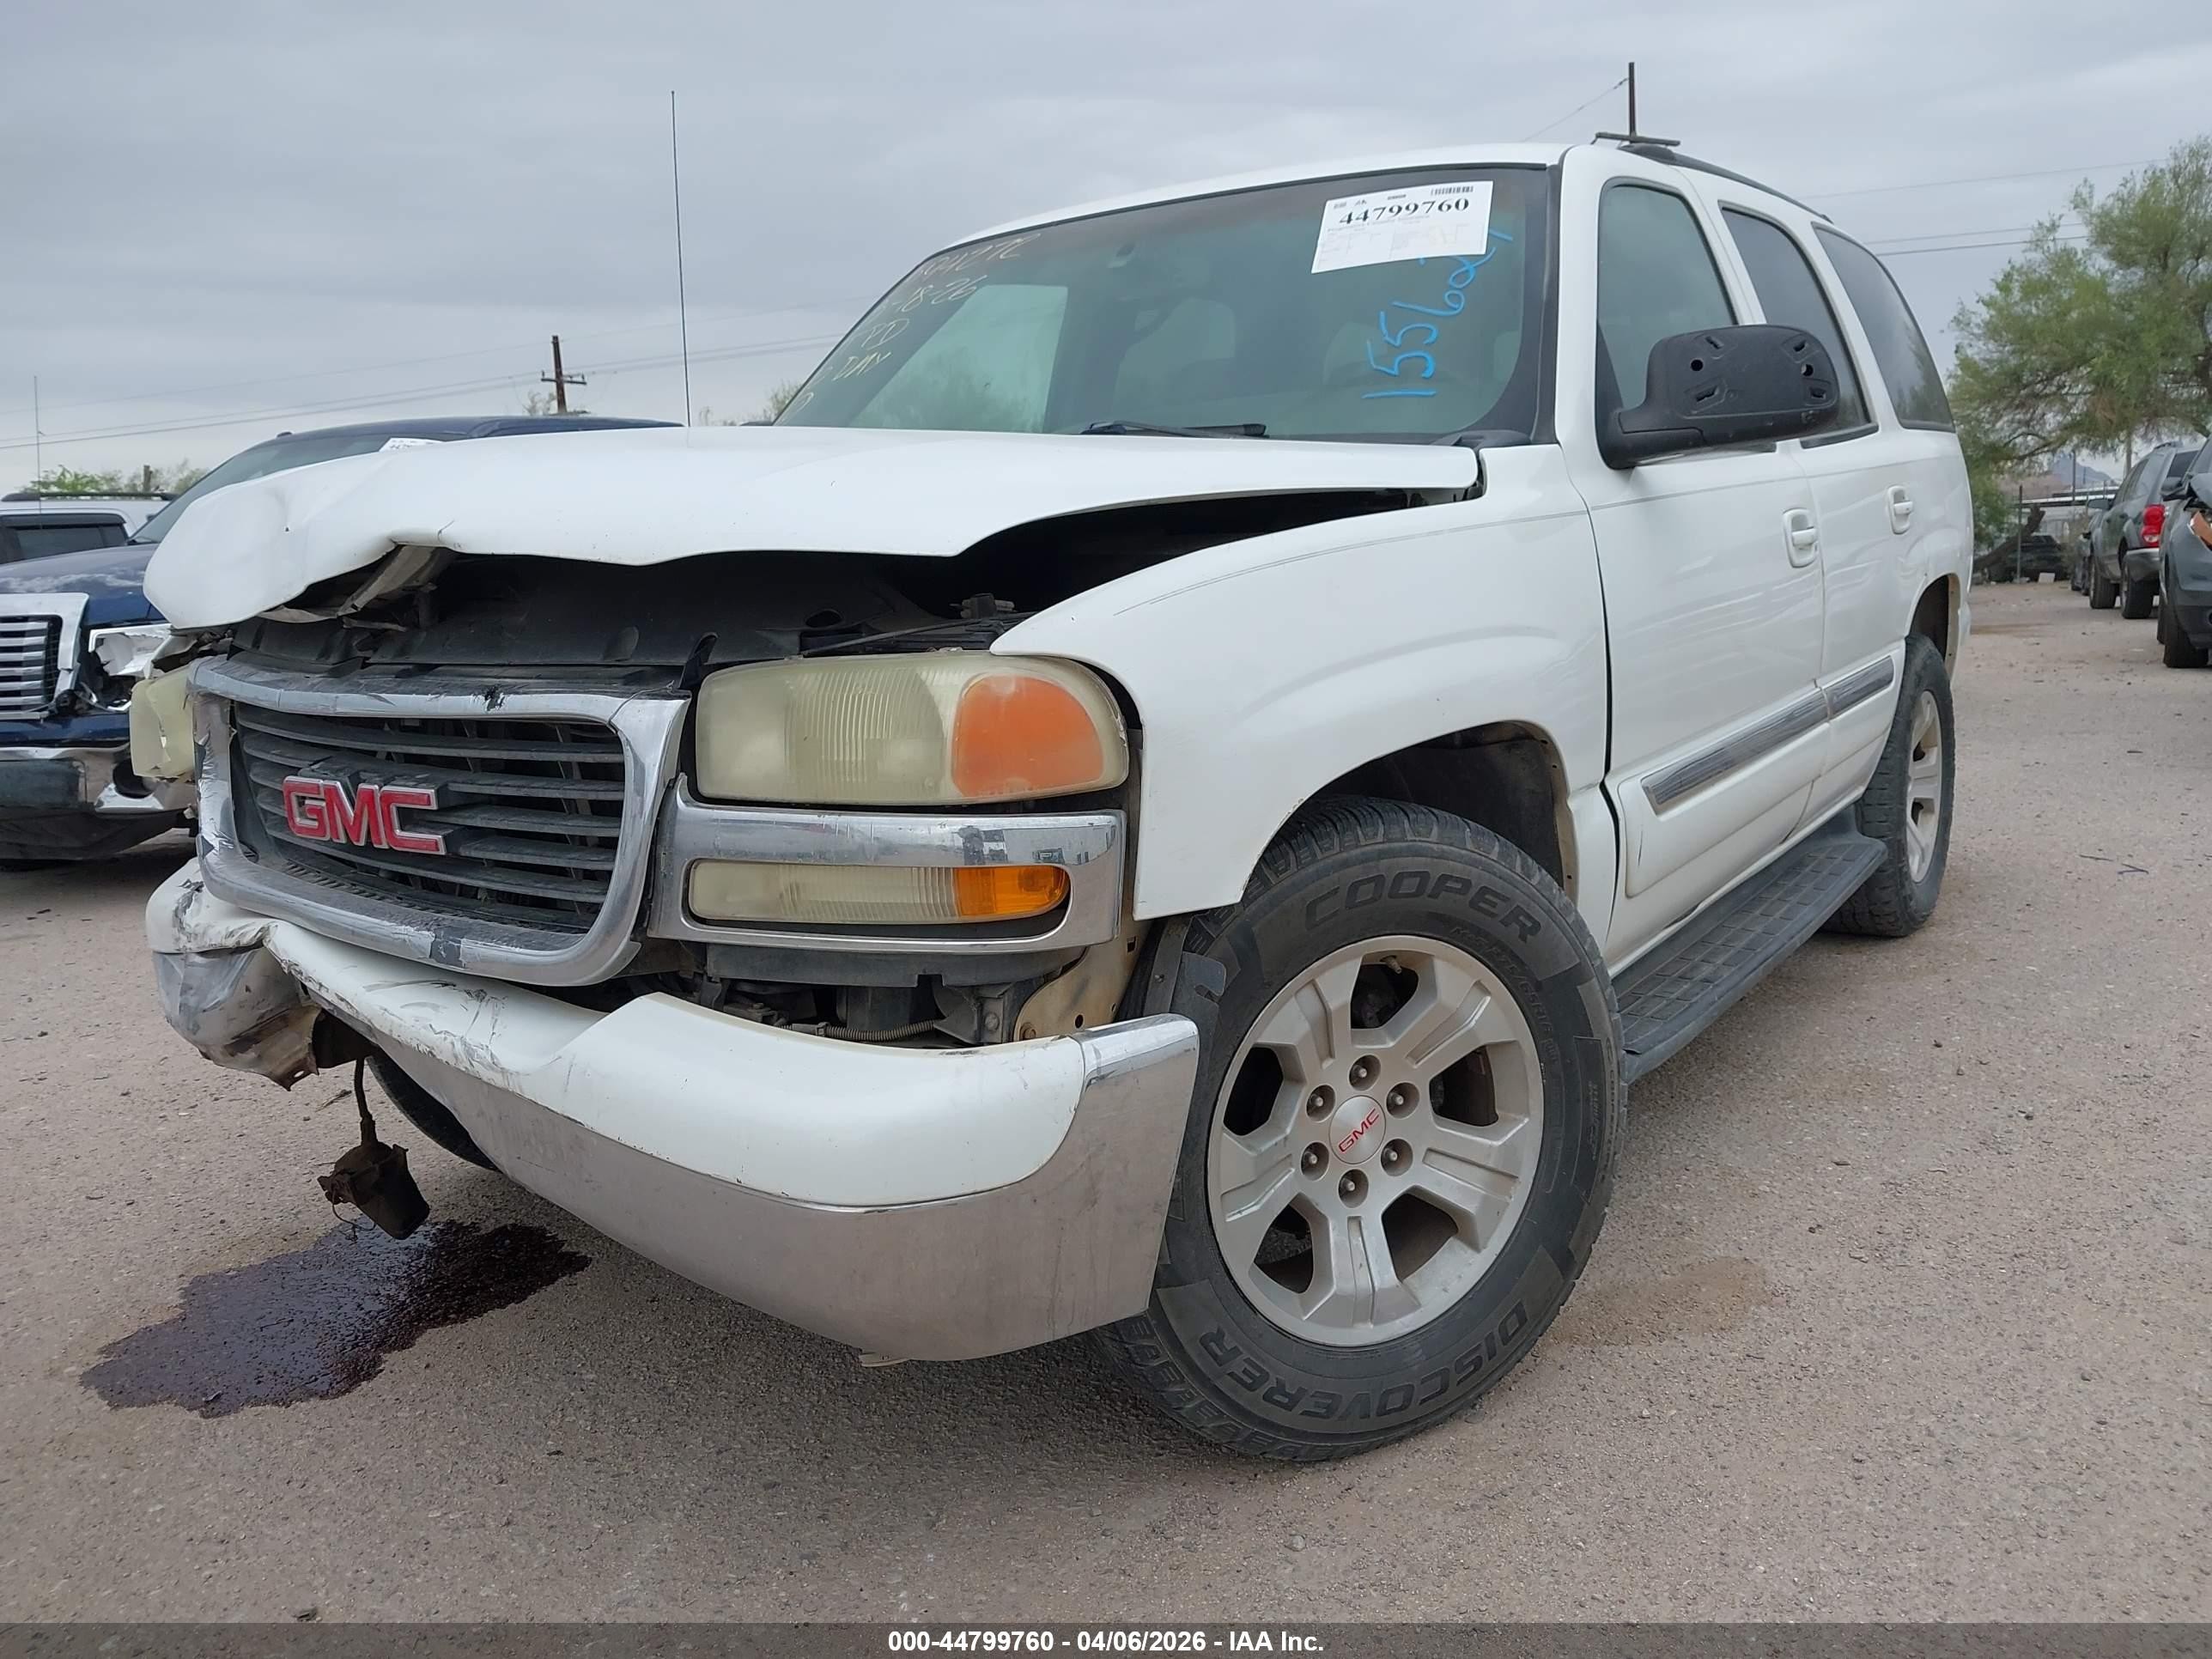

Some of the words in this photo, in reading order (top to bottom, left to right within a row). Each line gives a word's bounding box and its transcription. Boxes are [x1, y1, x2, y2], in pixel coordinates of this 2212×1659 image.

[1340, 198, 1469, 224] 44799760
[283, 775, 447, 854] GMC
[1303, 868, 1543, 943] COOPER
[1338, 1108, 1380, 1152] GMC
[1198, 1303, 1529, 1423] DISCOVERER
